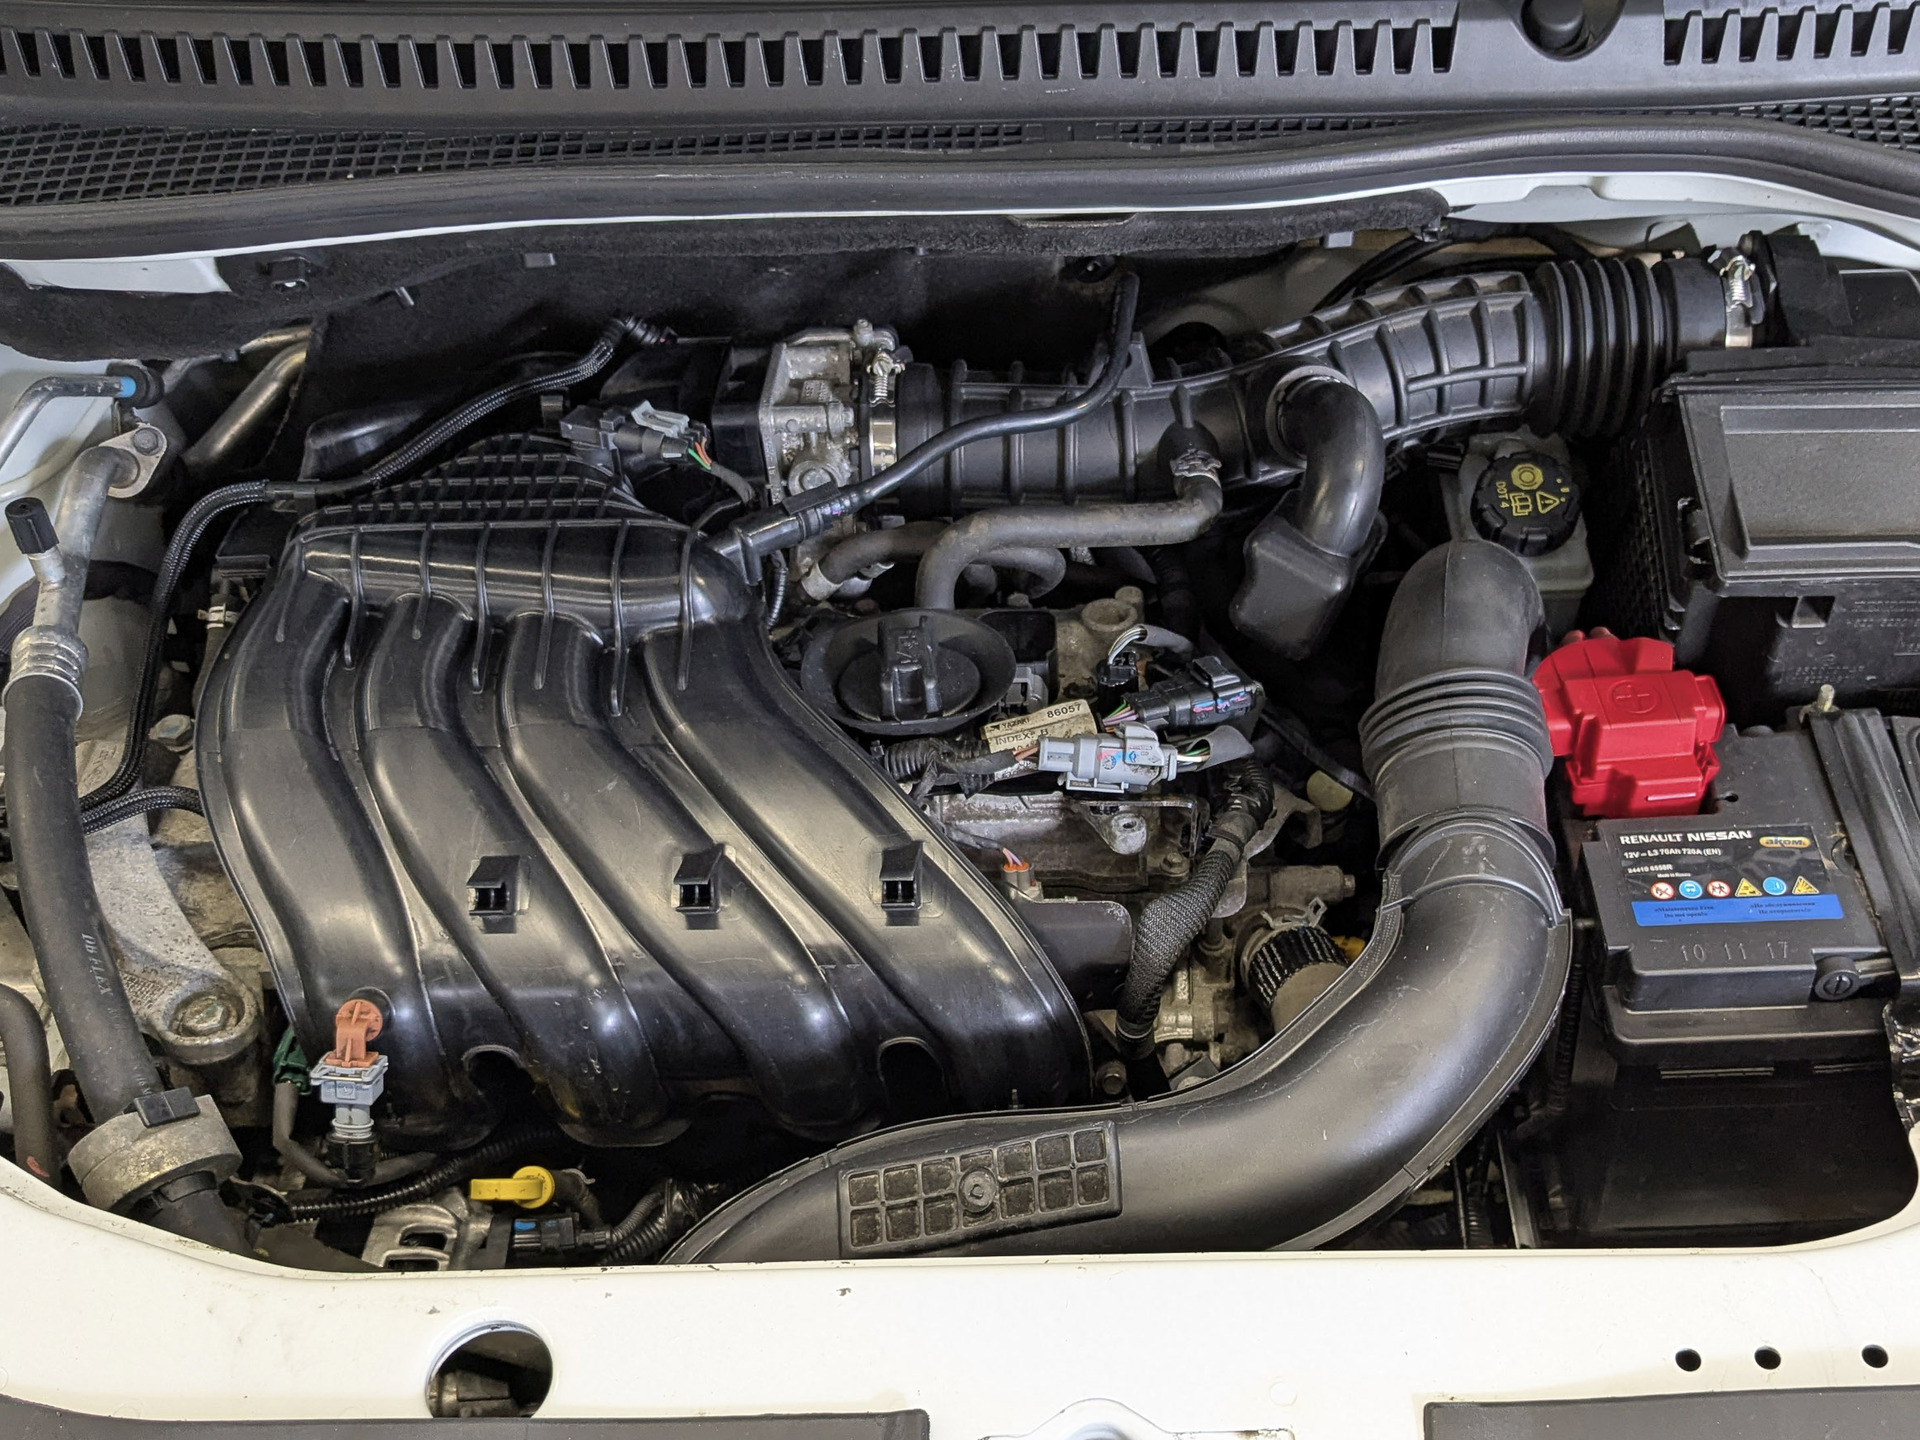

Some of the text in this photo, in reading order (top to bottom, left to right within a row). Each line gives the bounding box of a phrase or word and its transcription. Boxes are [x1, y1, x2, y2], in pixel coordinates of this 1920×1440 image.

[1496, 482, 1508, 499] DOT
[1046, 703, 1081, 719] 86057
[1002, 718, 1030, 729] YAZAKI
[1619, 829, 1752, 845] RENAULT NISSAN
[1623, 851, 1640, 859] 12V
[1682, 847, 1702, 856] 720A
[1703, 847, 1722, 857] (EN)
